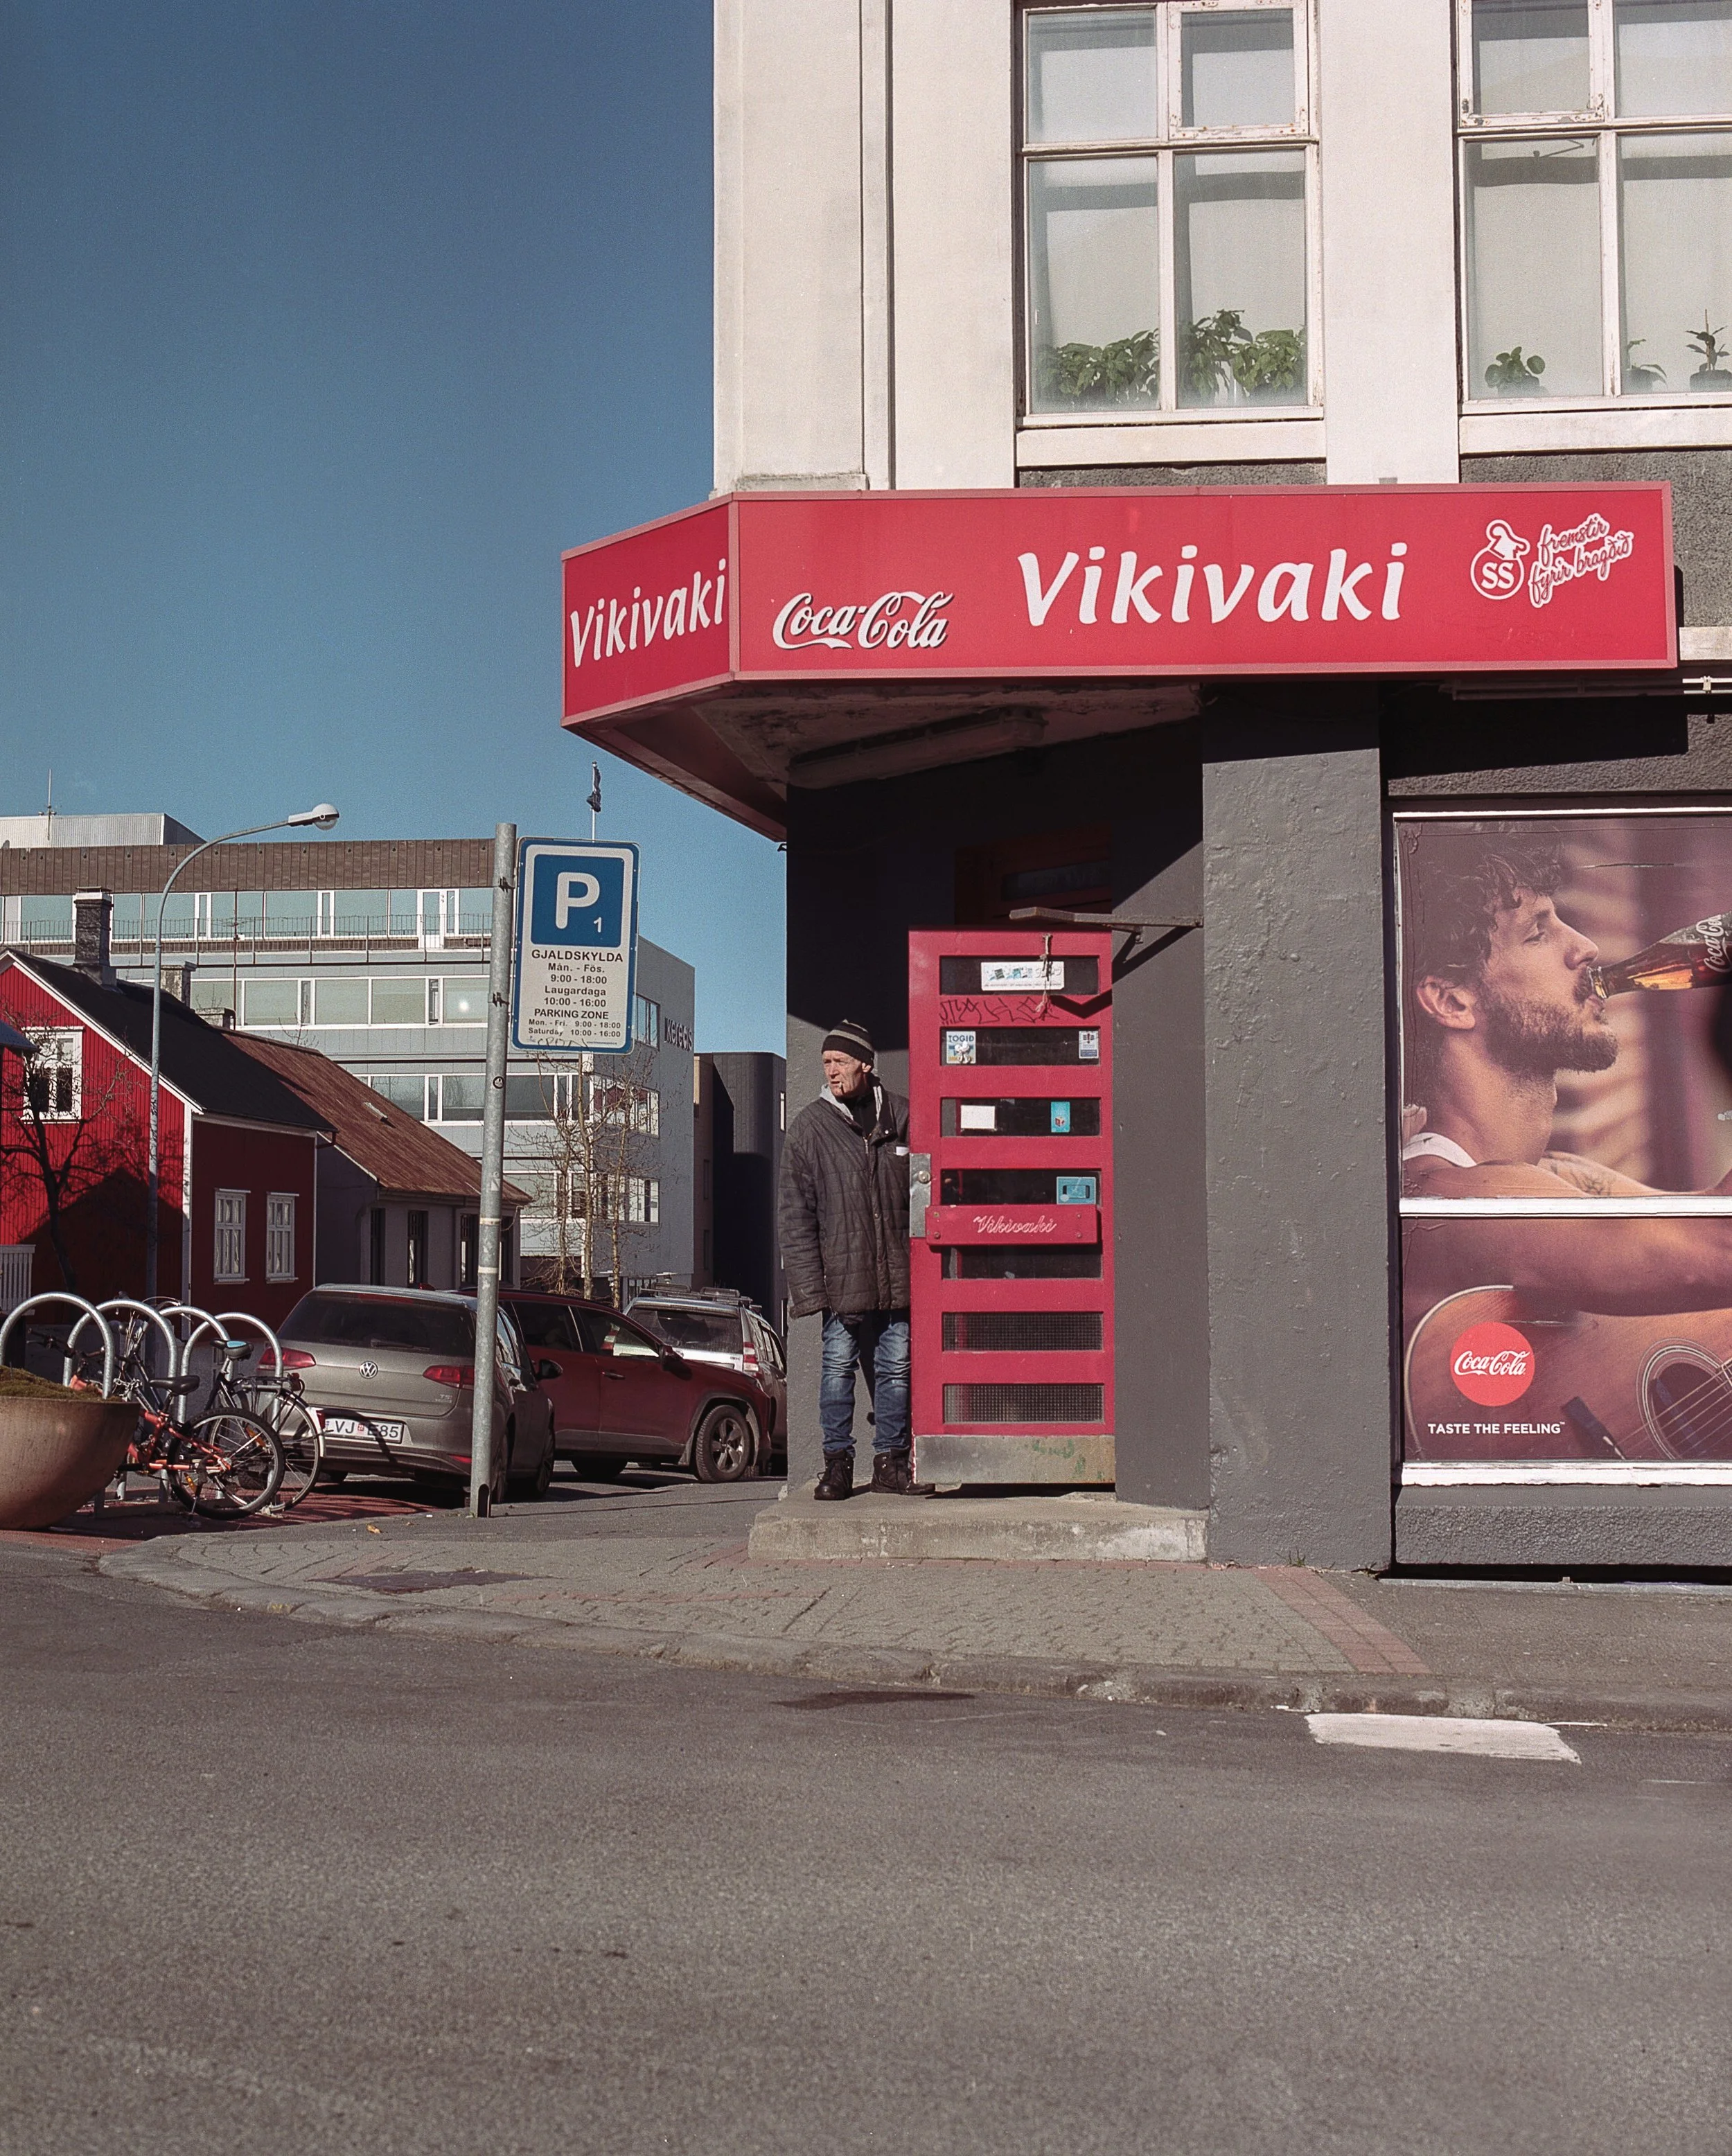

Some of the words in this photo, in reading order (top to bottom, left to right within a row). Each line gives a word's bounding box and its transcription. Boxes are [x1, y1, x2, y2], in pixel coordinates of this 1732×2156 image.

[1540, 516, 1607, 567] fremstir
[1481, 562, 1514, 589] SS
[1531, 558, 1571, 604] fyrir
[1017, 542, 1408, 626] Vikivaki
[570, 558, 727, 668] Vikivaki
[772, 591, 953, 649] Coca-Cola
[555, 872, 600, 930] P
[593, 917, 603, 933] 1
[531, 949, 624, 962] GJALDSKYLDA
[583, 964, 606, 973] Fös.
[551, 974, 572, 982] 9:00
[581, 975, 608, 984] 18:00
[545, 985, 607, 997] Laugardaga
[544, 997, 571, 1005] 10:00
[579, 998, 607, 1007] 16:00
[534, 1008, 579, 1018] PARKING
[581, 1010, 610, 1020] ZONE
[528, 1027, 563, 1036] Saturday
[1454, 1350, 1530, 1376] Coca-Cola
[1428, 1424, 1470, 1434] TASTE
[1474, 1424, 1500, 1434] THE
